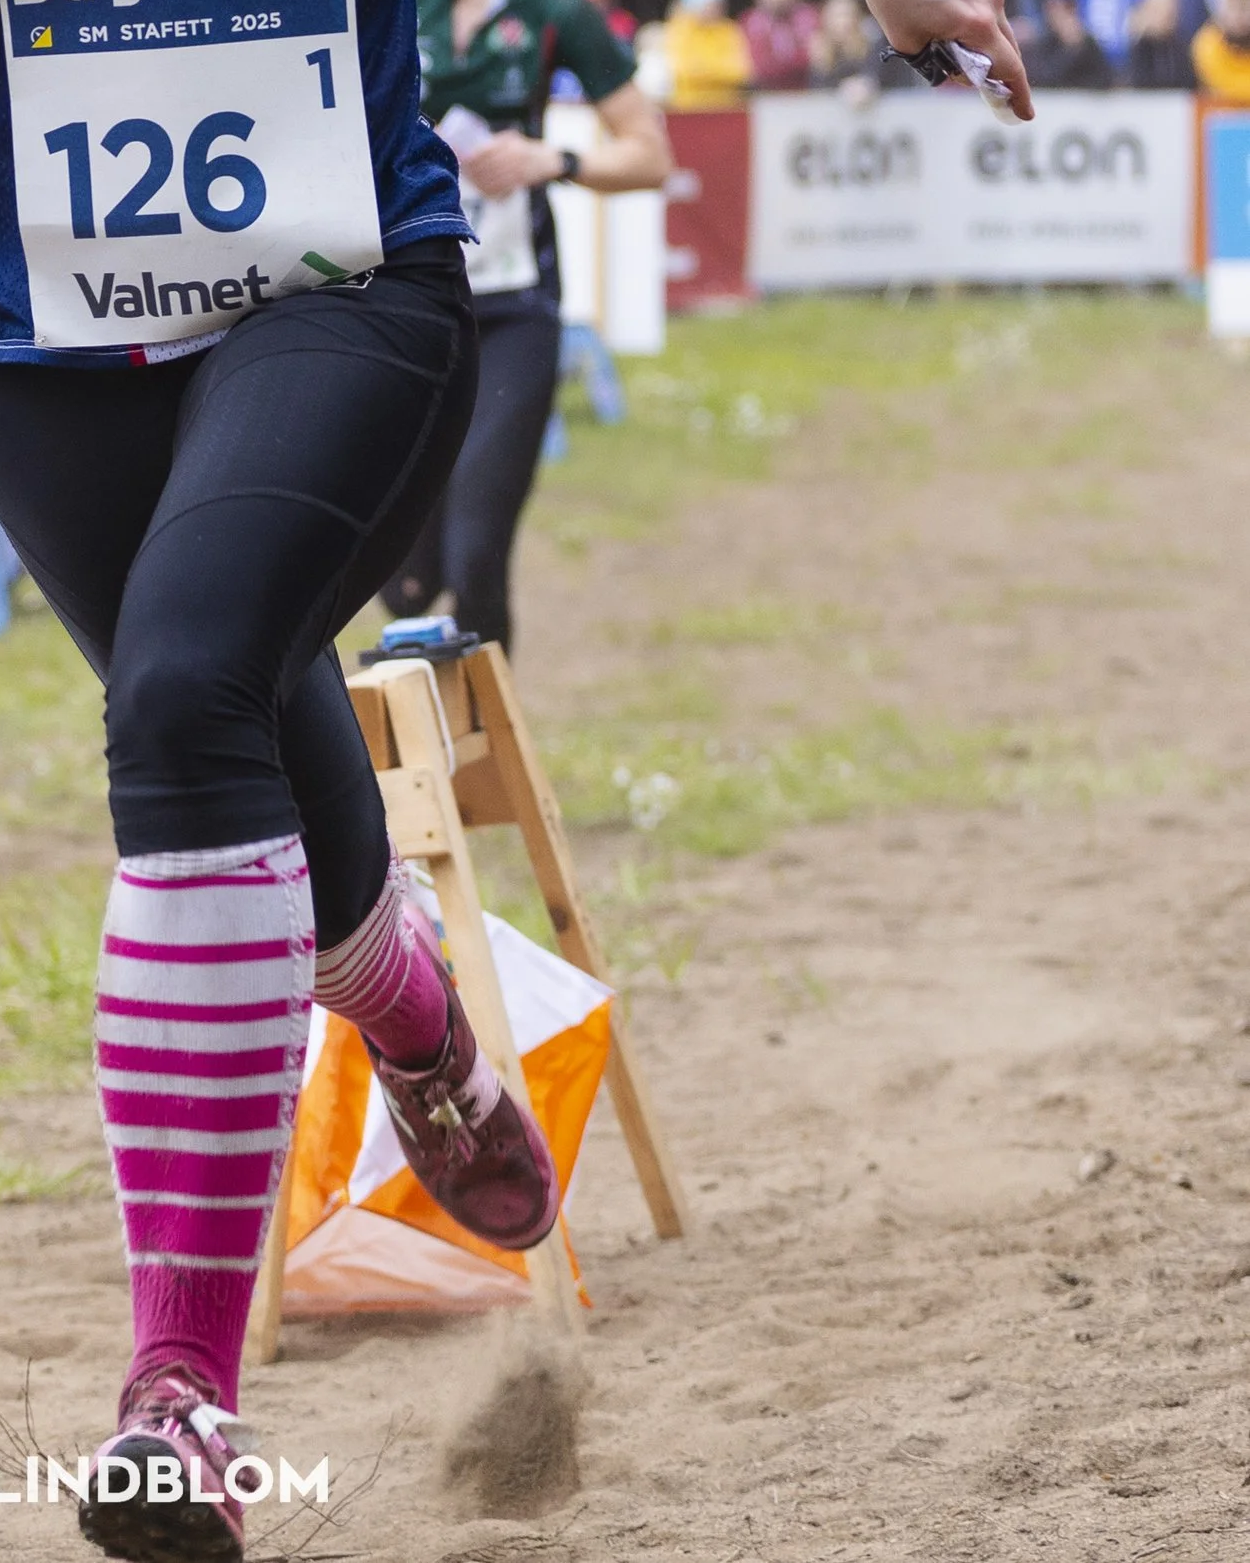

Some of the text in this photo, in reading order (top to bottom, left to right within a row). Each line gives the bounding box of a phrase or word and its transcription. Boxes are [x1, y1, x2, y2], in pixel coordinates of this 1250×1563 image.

[78, 12, 282, 44] SM STAFETT 2025
[305, 48, 336, 109] 1
[44, 111, 267, 239] 126
[72, 264, 270, 319] Valmet
